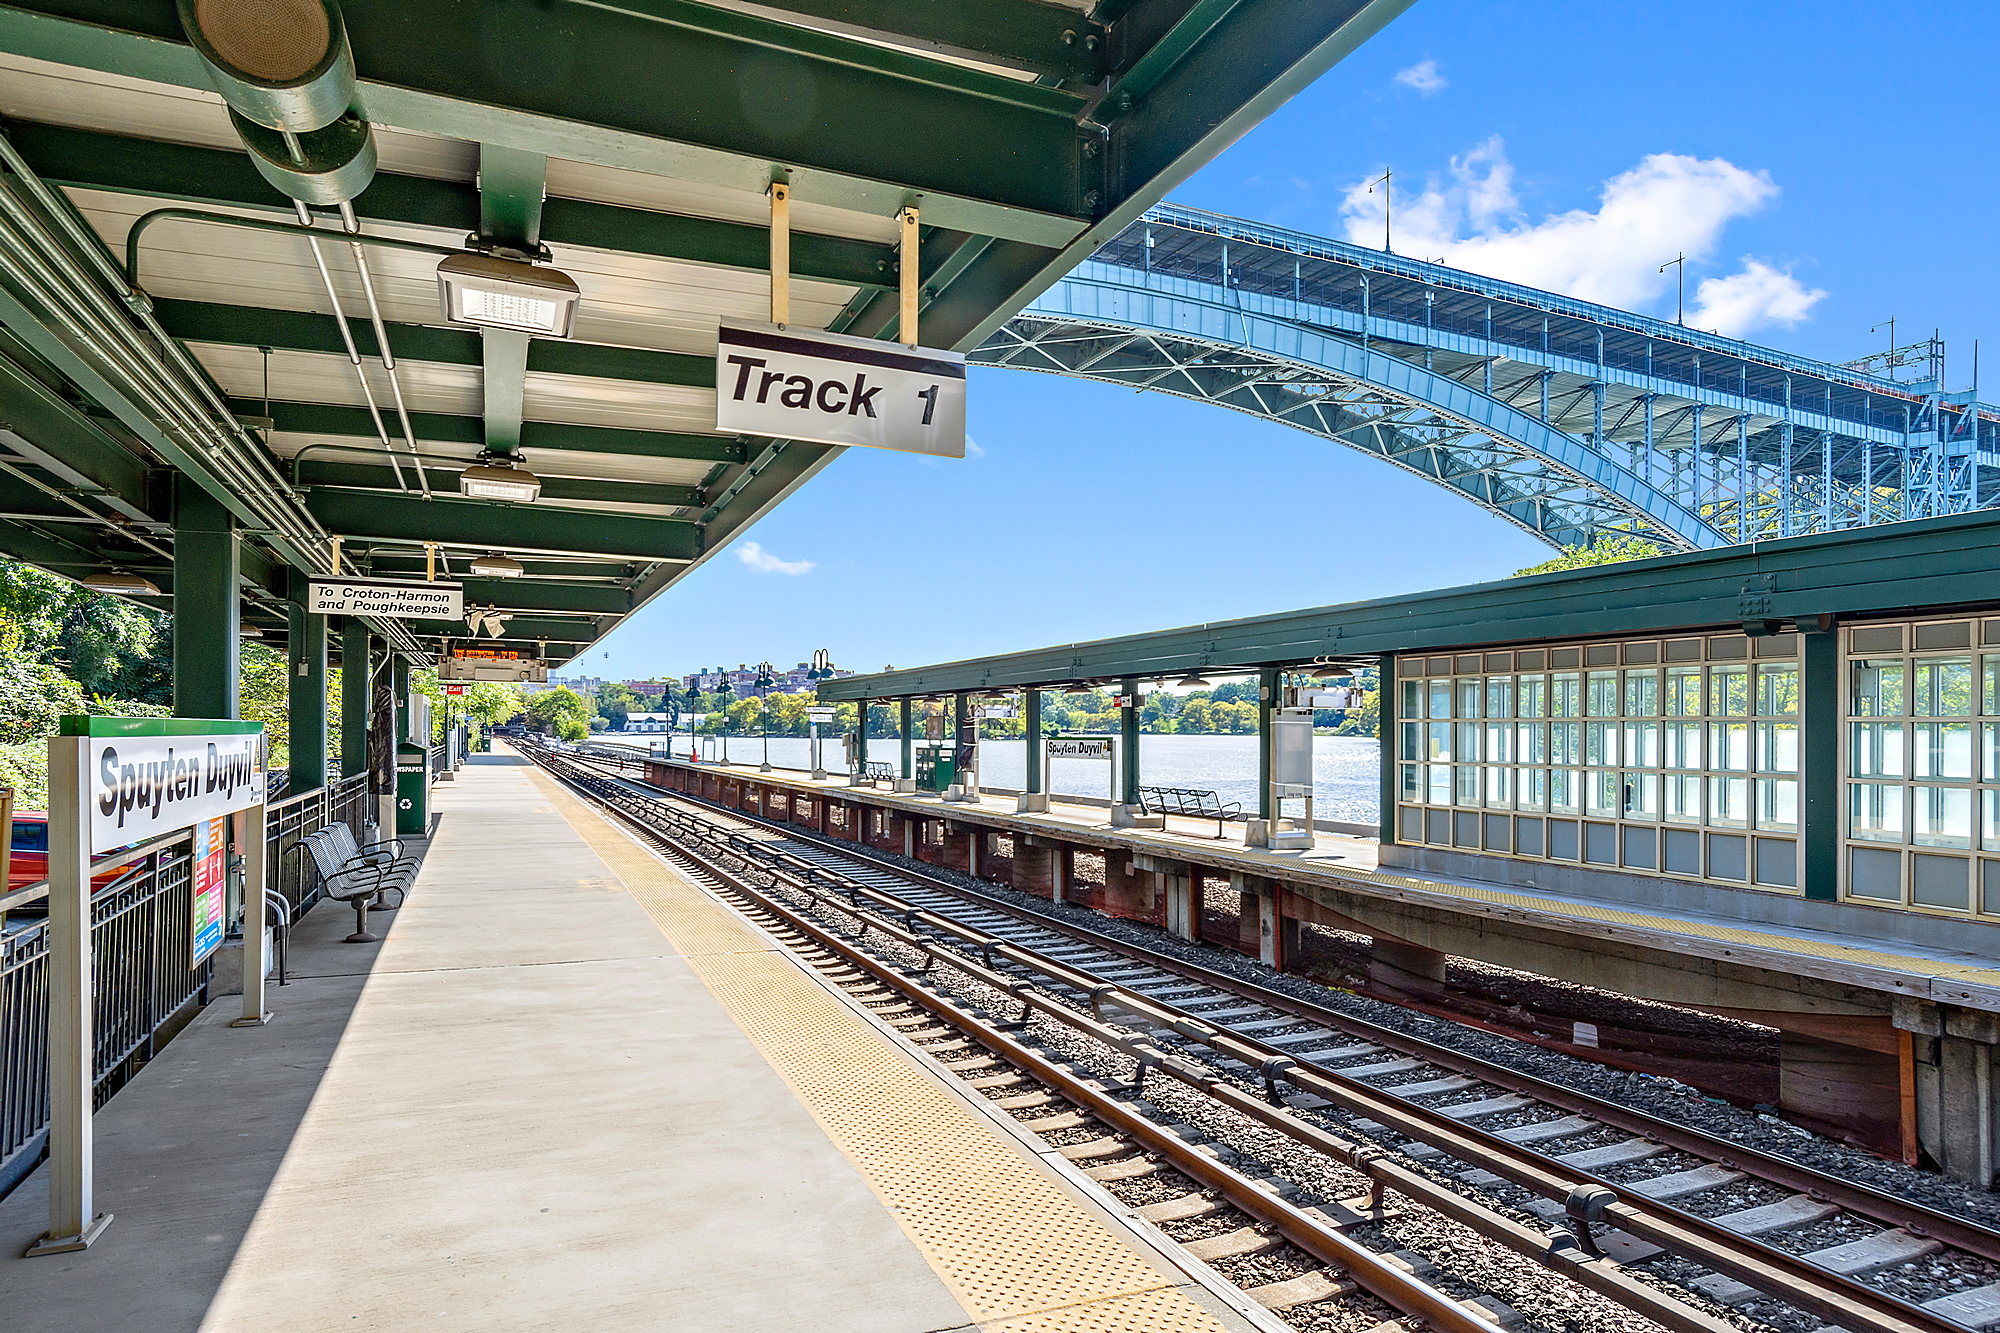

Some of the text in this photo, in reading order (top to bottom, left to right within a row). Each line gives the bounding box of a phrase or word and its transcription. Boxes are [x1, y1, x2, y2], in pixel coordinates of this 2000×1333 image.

[726, 354, 939, 425] Track 1
[317, 586, 450, 602] To Croton-Harmon
[317, 600, 450, 615] and Poughkeepsie
[1048, 741, 1103, 756] Spuyten Duyvil
[98, 740, 253, 828] Spuyten Duyvil
